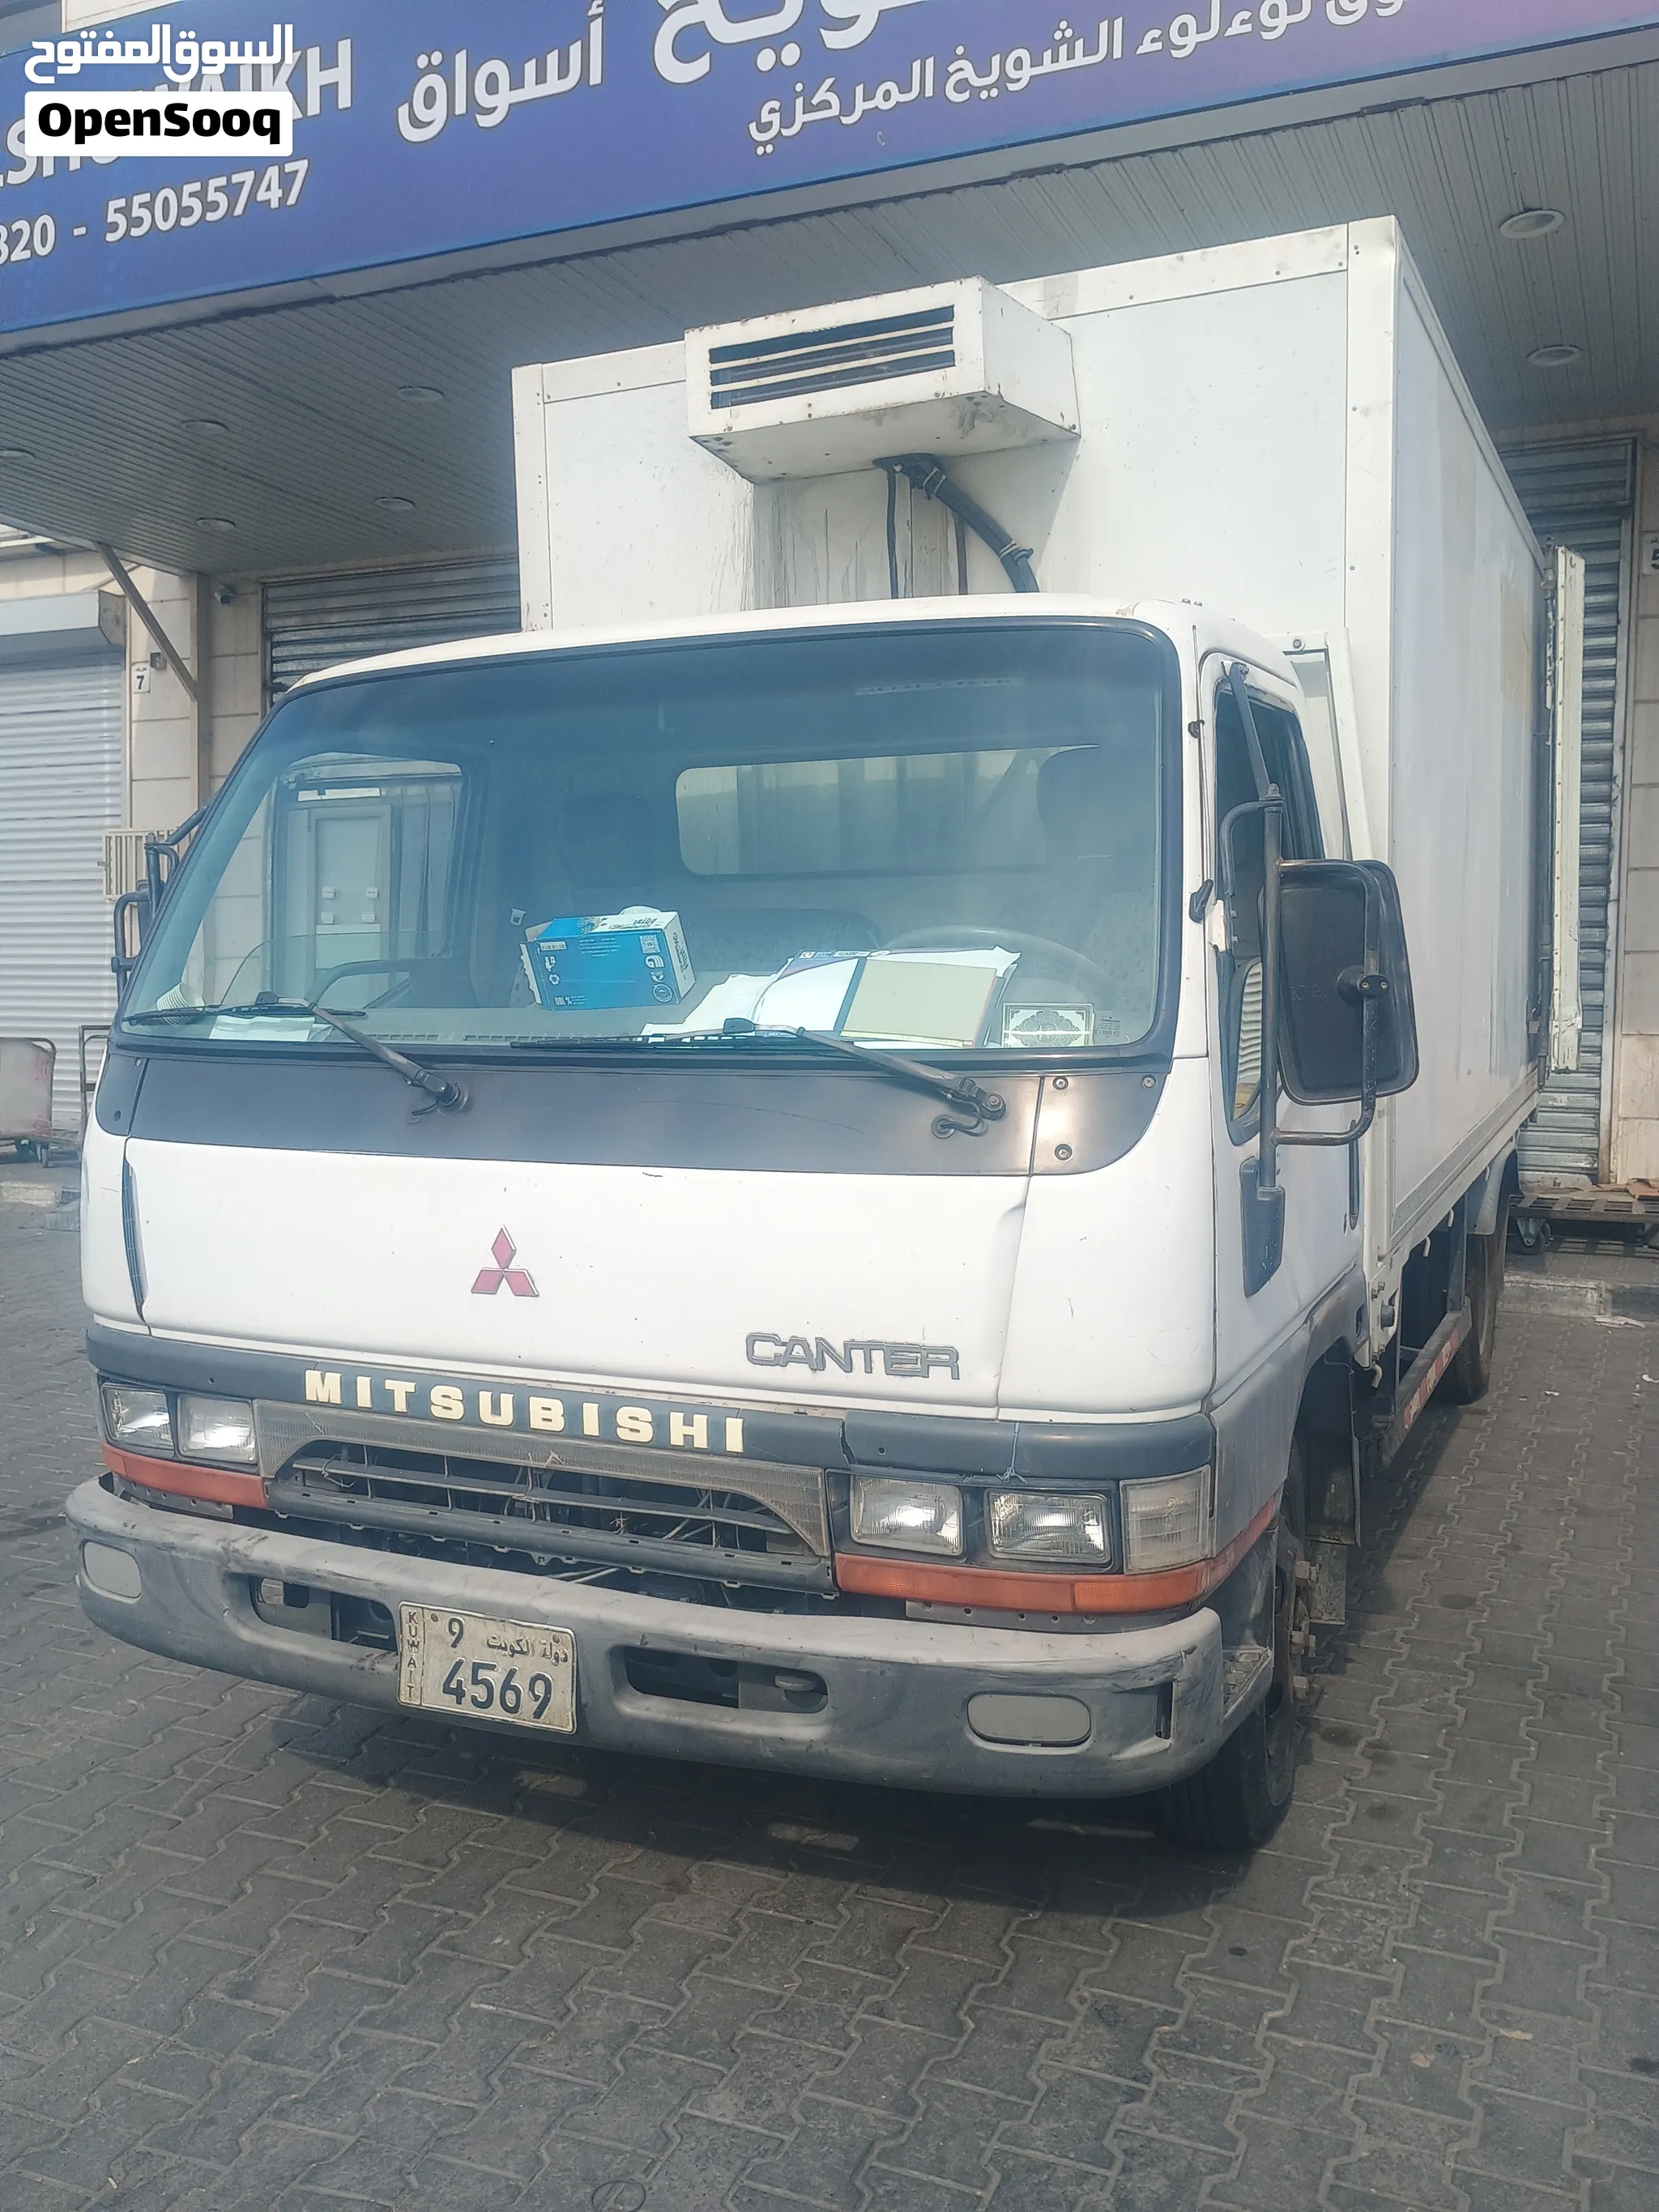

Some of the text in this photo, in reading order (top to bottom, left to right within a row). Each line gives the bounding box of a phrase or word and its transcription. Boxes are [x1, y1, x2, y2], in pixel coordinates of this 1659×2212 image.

[398, 0, 603, 143] أسواق
[944, 16, 1124, 103] الشويخ
[748, 56, 935, 156] المركزي
[105, 160, 309, 242] 55055747
[136, 675, 144, 690] 7
[745, 1332, 960, 1380] CANTER
[305, 1369, 744, 1454] MITSUBISHI
[407, 1610, 420, 1698] KUWAIT
[448, 1617, 464, 1648] 9
[487, 1635, 569, 1666] دولة الكويت
[442, 1658, 553, 1720] 4569
